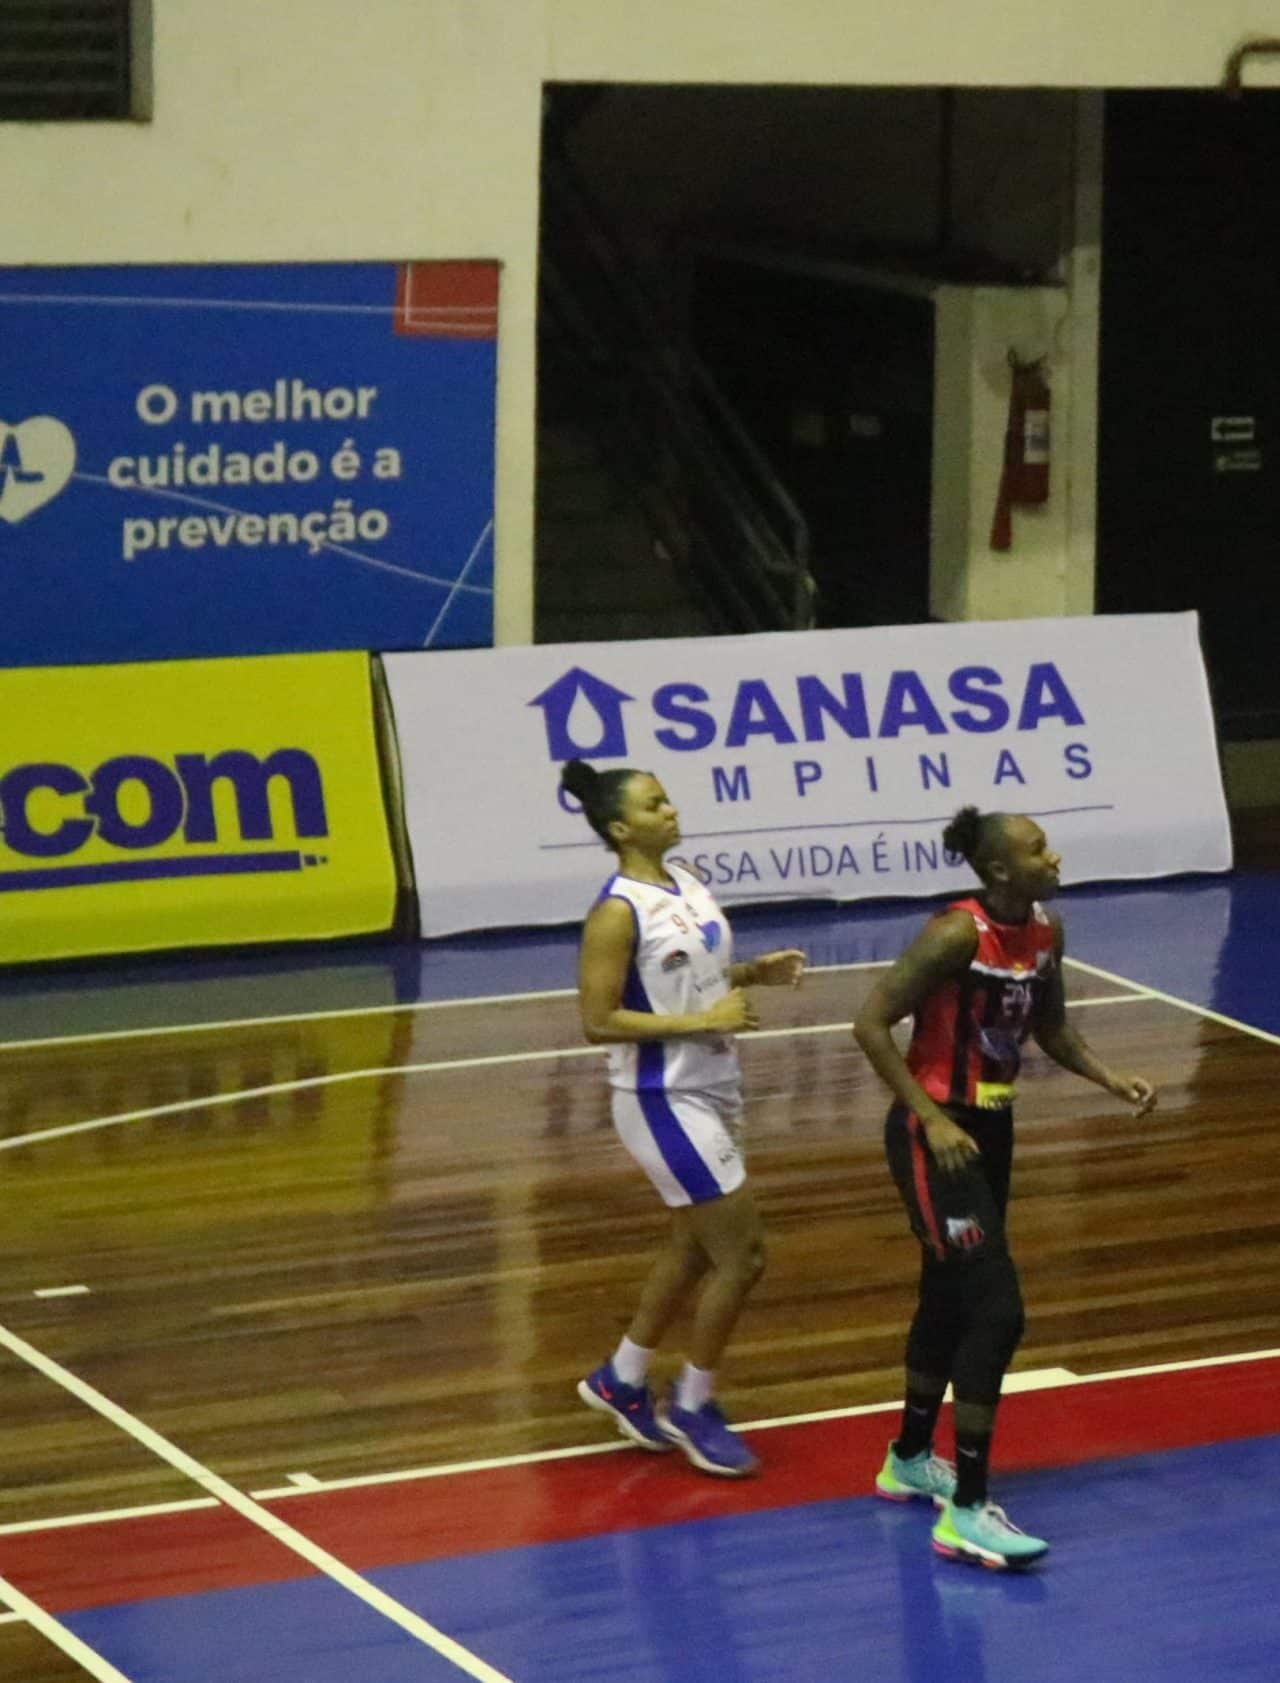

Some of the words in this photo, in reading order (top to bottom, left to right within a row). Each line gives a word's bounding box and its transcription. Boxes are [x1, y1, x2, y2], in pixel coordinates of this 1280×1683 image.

[136, 384, 176, 424] O
[191, 379, 378, 422] melhor
[107, 442, 318, 487] cuidado
[331, 438, 360, 479] é
[372, 448, 402, 478] a
[122, 500, 389, 561] prevenção
[651, 662, 1086, 752] SANASA
[0, 748, 329, 857] com
[557, 744, 1093, 814] MPINAS
[769, 841, 860, 880] VIDA
[873, 833, 890, 872] É
